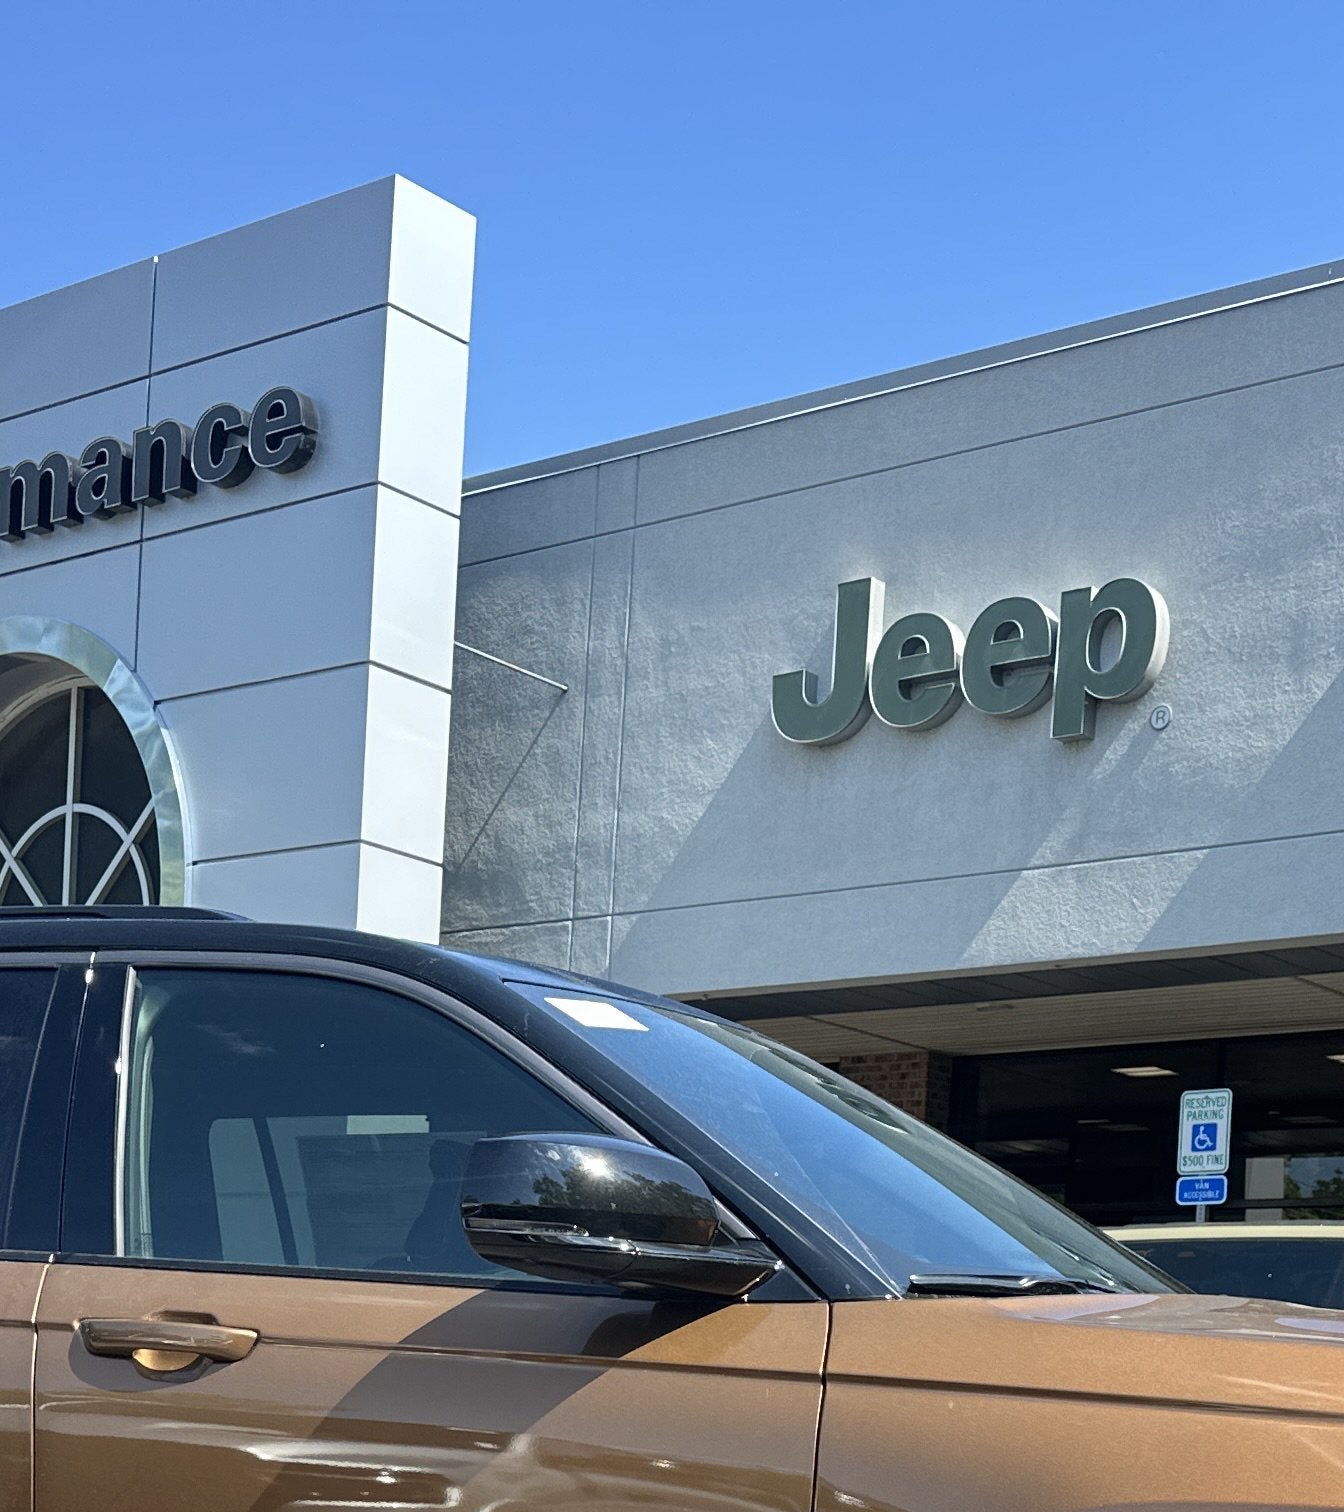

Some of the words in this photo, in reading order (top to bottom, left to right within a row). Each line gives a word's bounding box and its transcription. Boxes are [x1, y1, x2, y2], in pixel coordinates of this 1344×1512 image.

[770, 576, 1171, 747] Jeep
[1185, 1096, 1227, 1109] RESERVED
[1186, 1108, 1225, 1120] PARKING
[1182, 1155, 1205, 1167] $500
[1206, 1154, 1224, 1165] FINE
